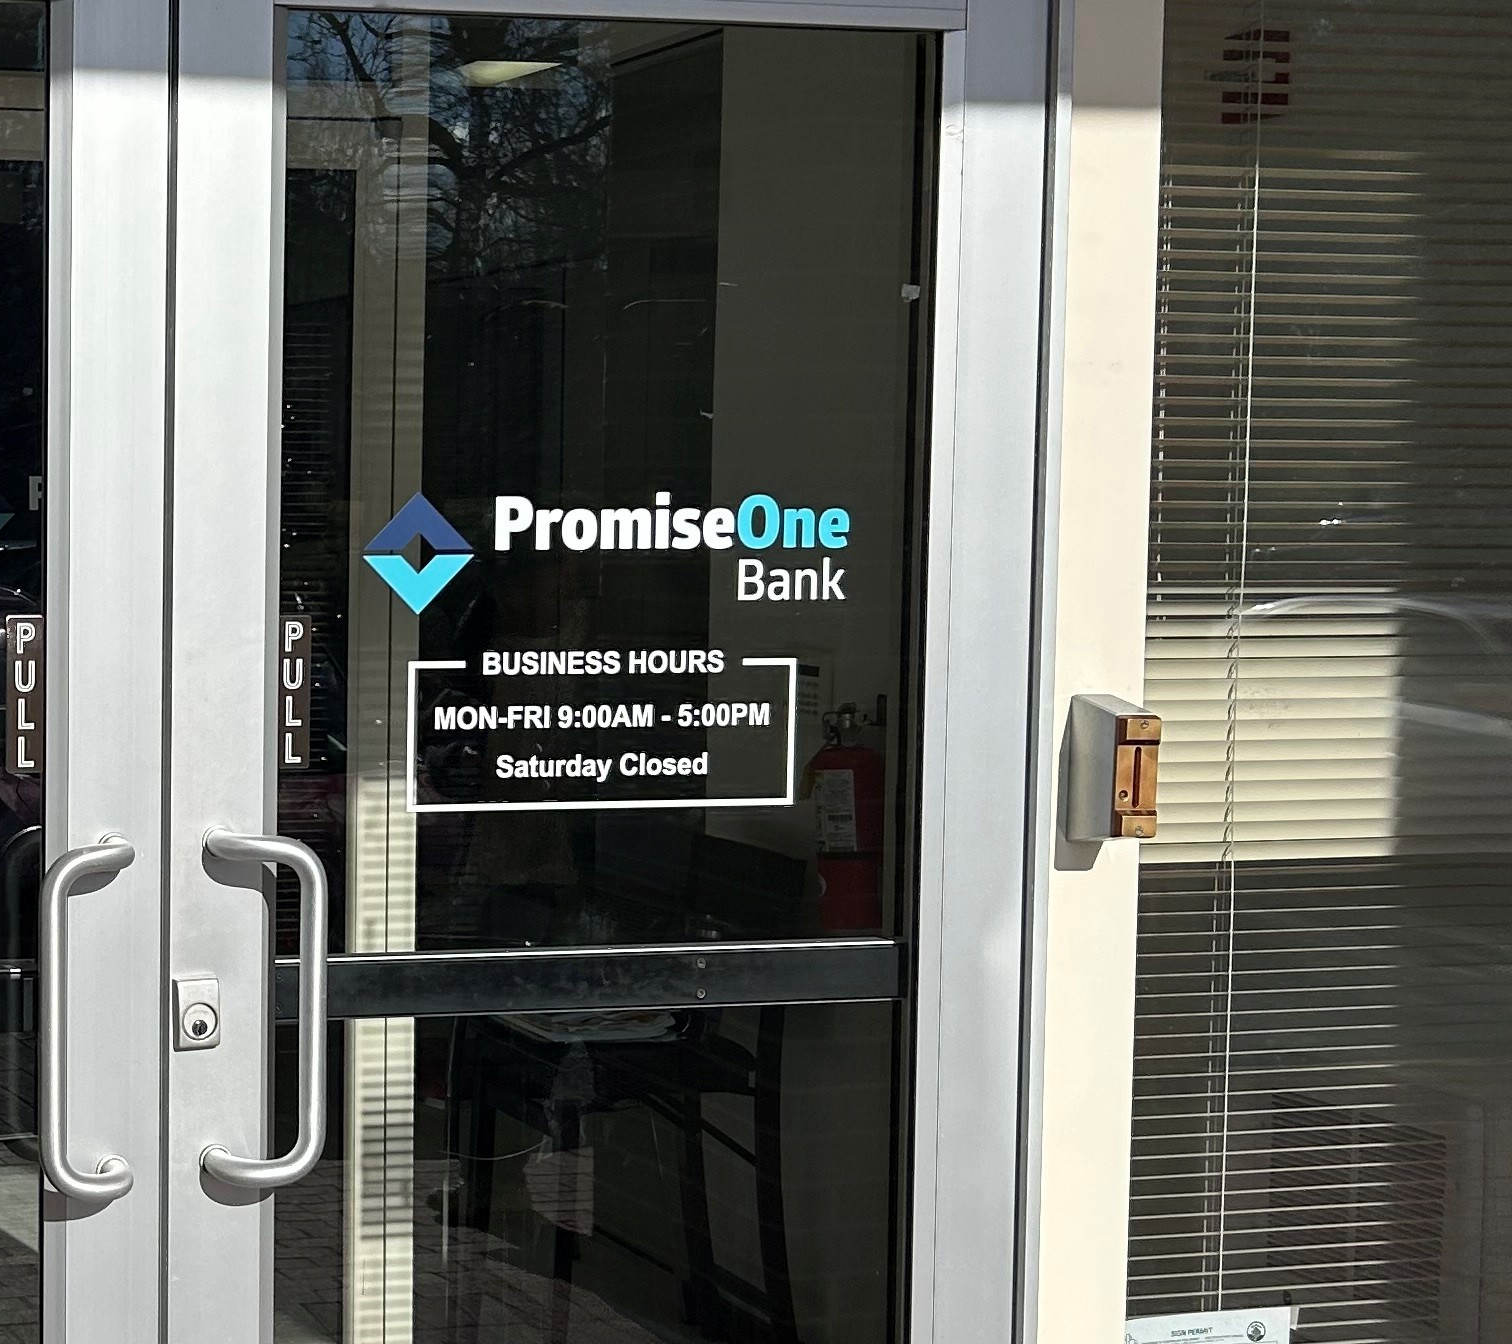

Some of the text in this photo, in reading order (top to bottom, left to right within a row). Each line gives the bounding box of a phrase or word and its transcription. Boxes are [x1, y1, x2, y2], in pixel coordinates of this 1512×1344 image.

[495, 492, 849, 550] PromiseOne
[738, 557, 846, 600] Bank
[483, 650, 724, 675] BUSINESS HOURS
[15, 623, 35, 767] PULL
[283, 622, 303, 763] PULL
[435, 706, 550, 730] MON-FRI
[558, 704, 653, 728] 9:00AM
[678, 703, 769, 726] 5:00PM
[496, 752, 708, 782] Saturday Closed
